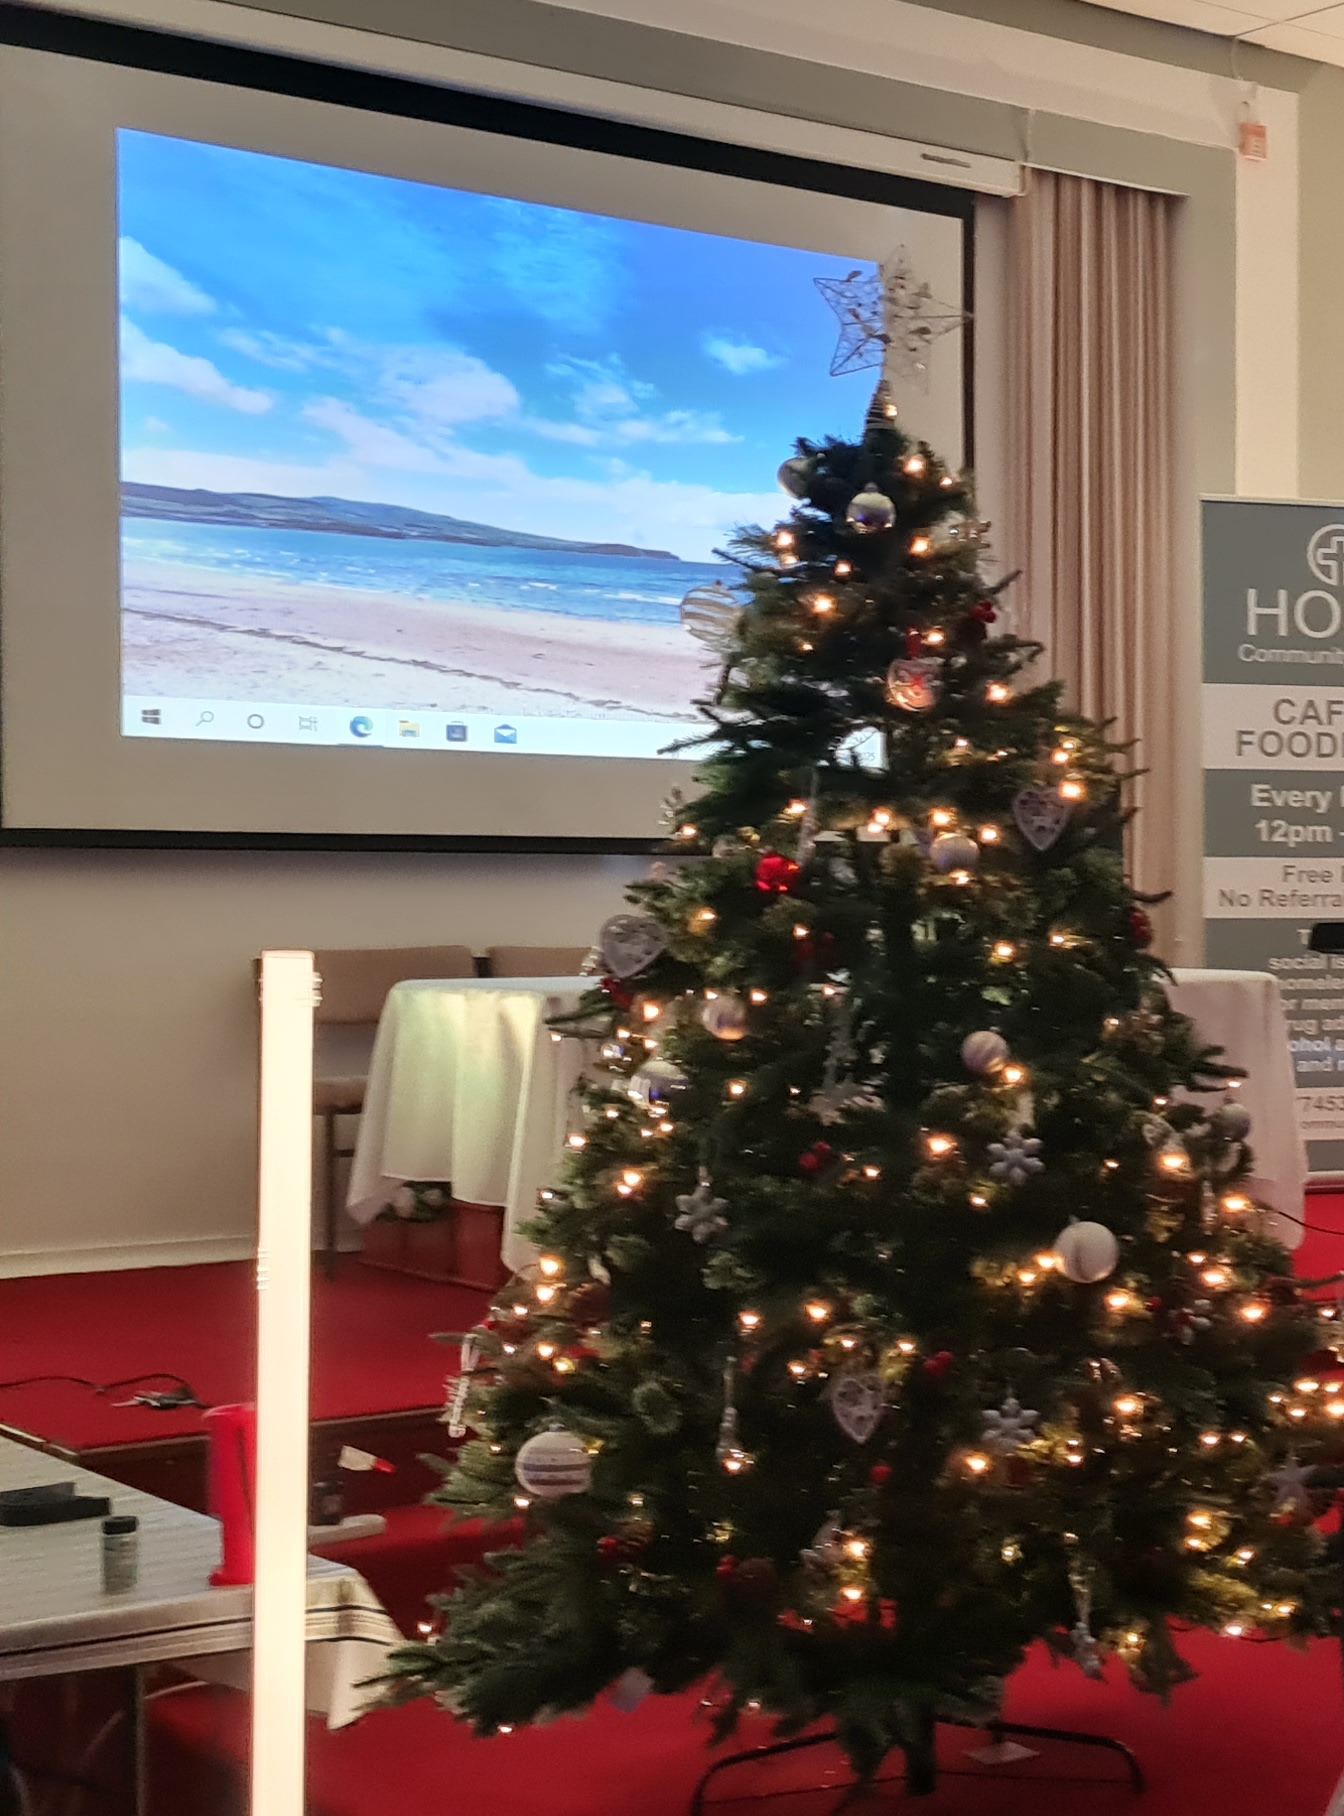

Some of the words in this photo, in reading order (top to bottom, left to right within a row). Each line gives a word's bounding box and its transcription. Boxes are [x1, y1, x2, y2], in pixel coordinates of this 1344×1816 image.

[1250, 783, 1333, 814] Every
[1255, 819, 1334, 848] 12pm
[1281, 864, 1334, 884] Free
[1218, 888, 1251, 908] No
[1269, 953, 1328, 970] social
[1286, 1019, 1319, 1036] rug
[1296, 1056, 1333, 1073] and
